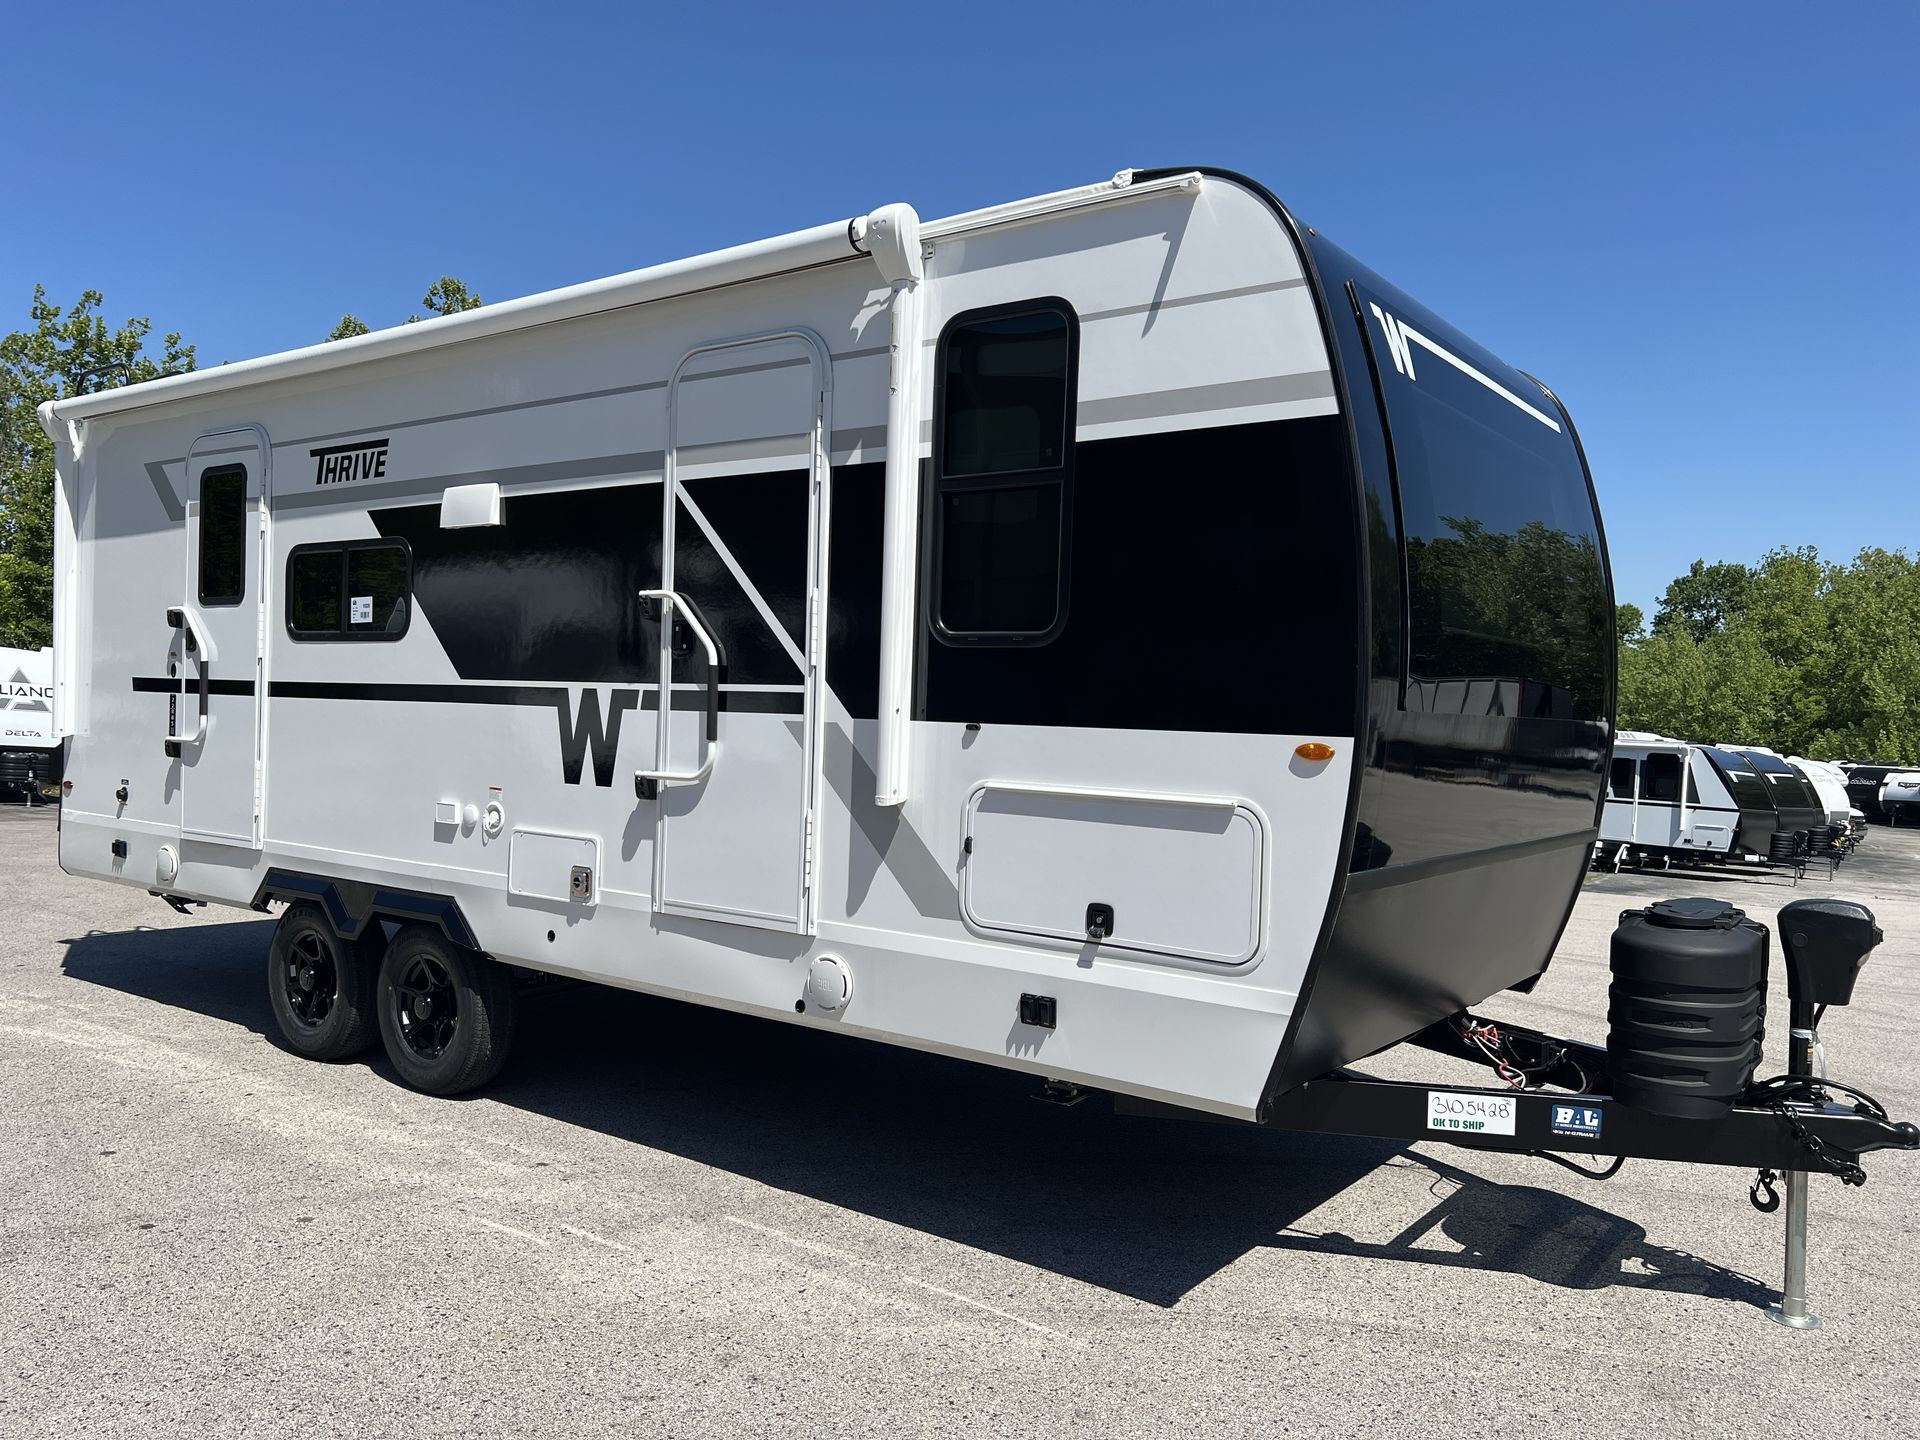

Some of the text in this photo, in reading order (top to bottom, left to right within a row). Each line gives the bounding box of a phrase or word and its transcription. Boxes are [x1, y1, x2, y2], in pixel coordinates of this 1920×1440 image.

[309, 438, 389, 485] THRIVE
[557, 687, 640, 787] W
[1432, 1096, 1510, 1118] 3105428
[1432, 1118, 1485, 1130] OK TO SHIP
